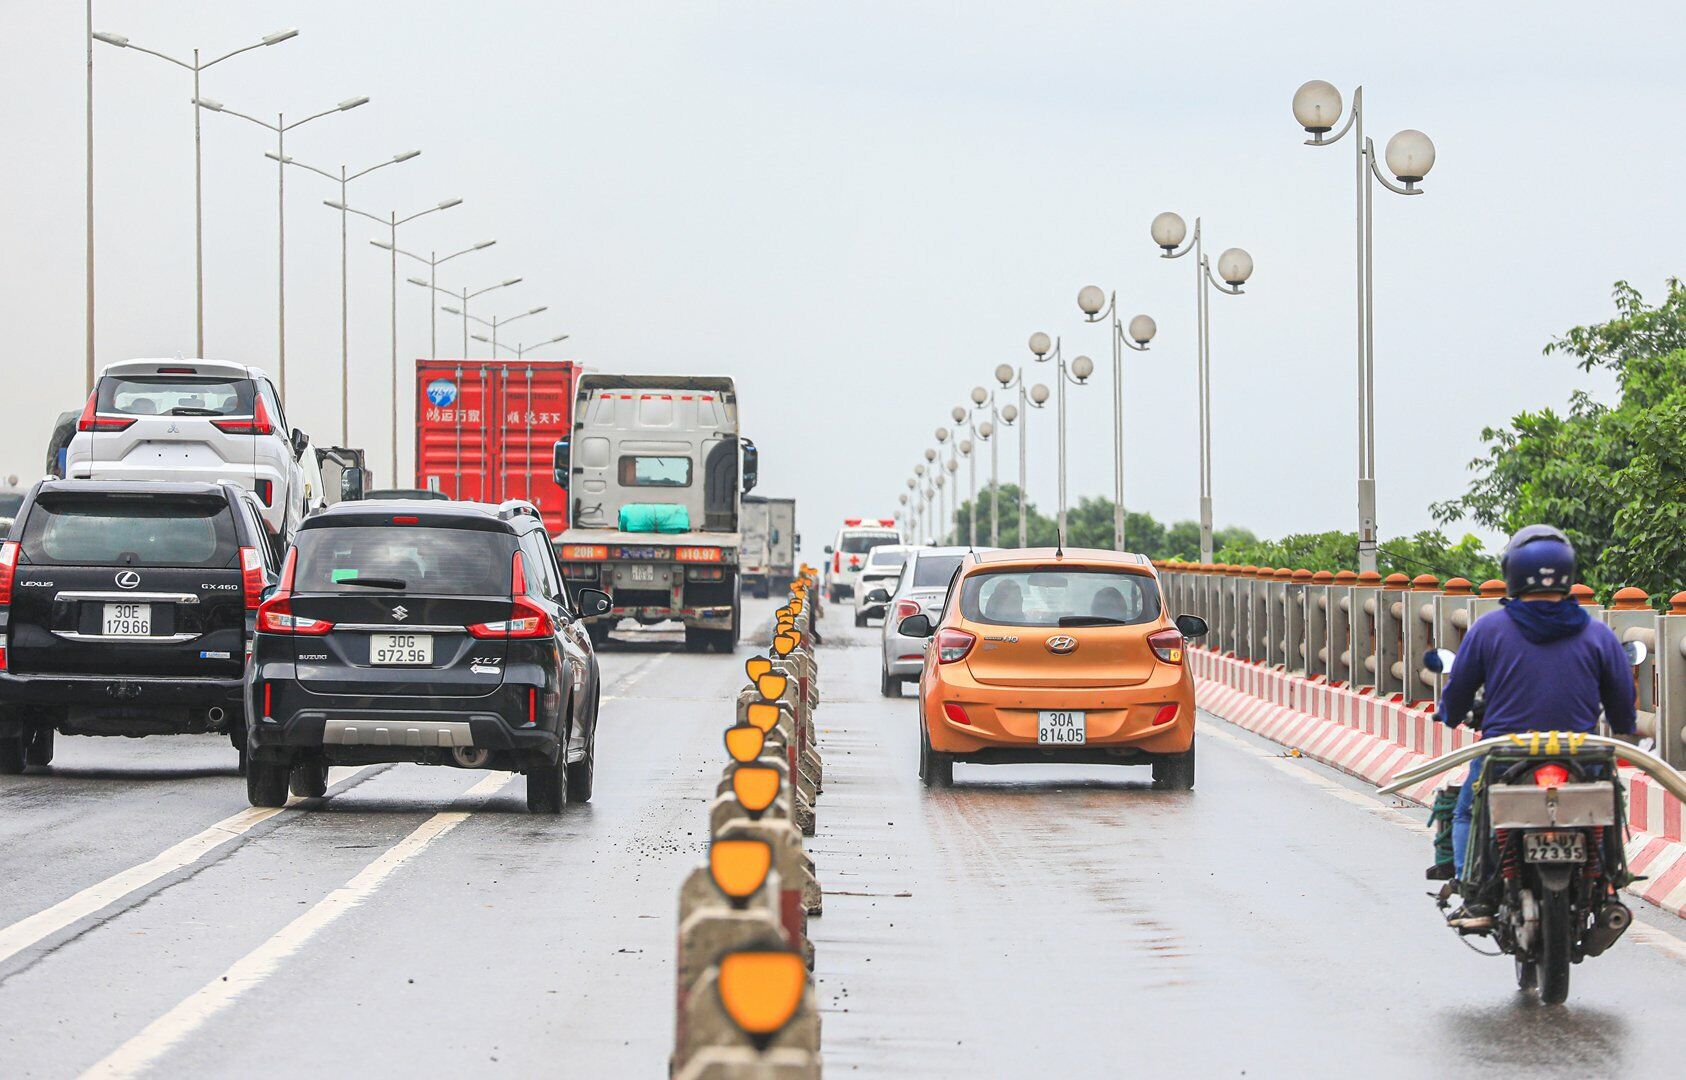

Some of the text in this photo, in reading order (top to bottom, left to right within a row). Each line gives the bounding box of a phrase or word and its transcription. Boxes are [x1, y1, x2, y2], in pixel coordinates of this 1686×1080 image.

[115, 605, 140, 619] 30E
[107, 619, 149, 634] 179.66
[388, 635, 415, 648] 30G
[377, 649, 425, 662] 972.96
[470, 657, 502, 665] XL7
[1049, 712, 1074, 727] 30A
[1040, 727, 1083, 742] 814.05
